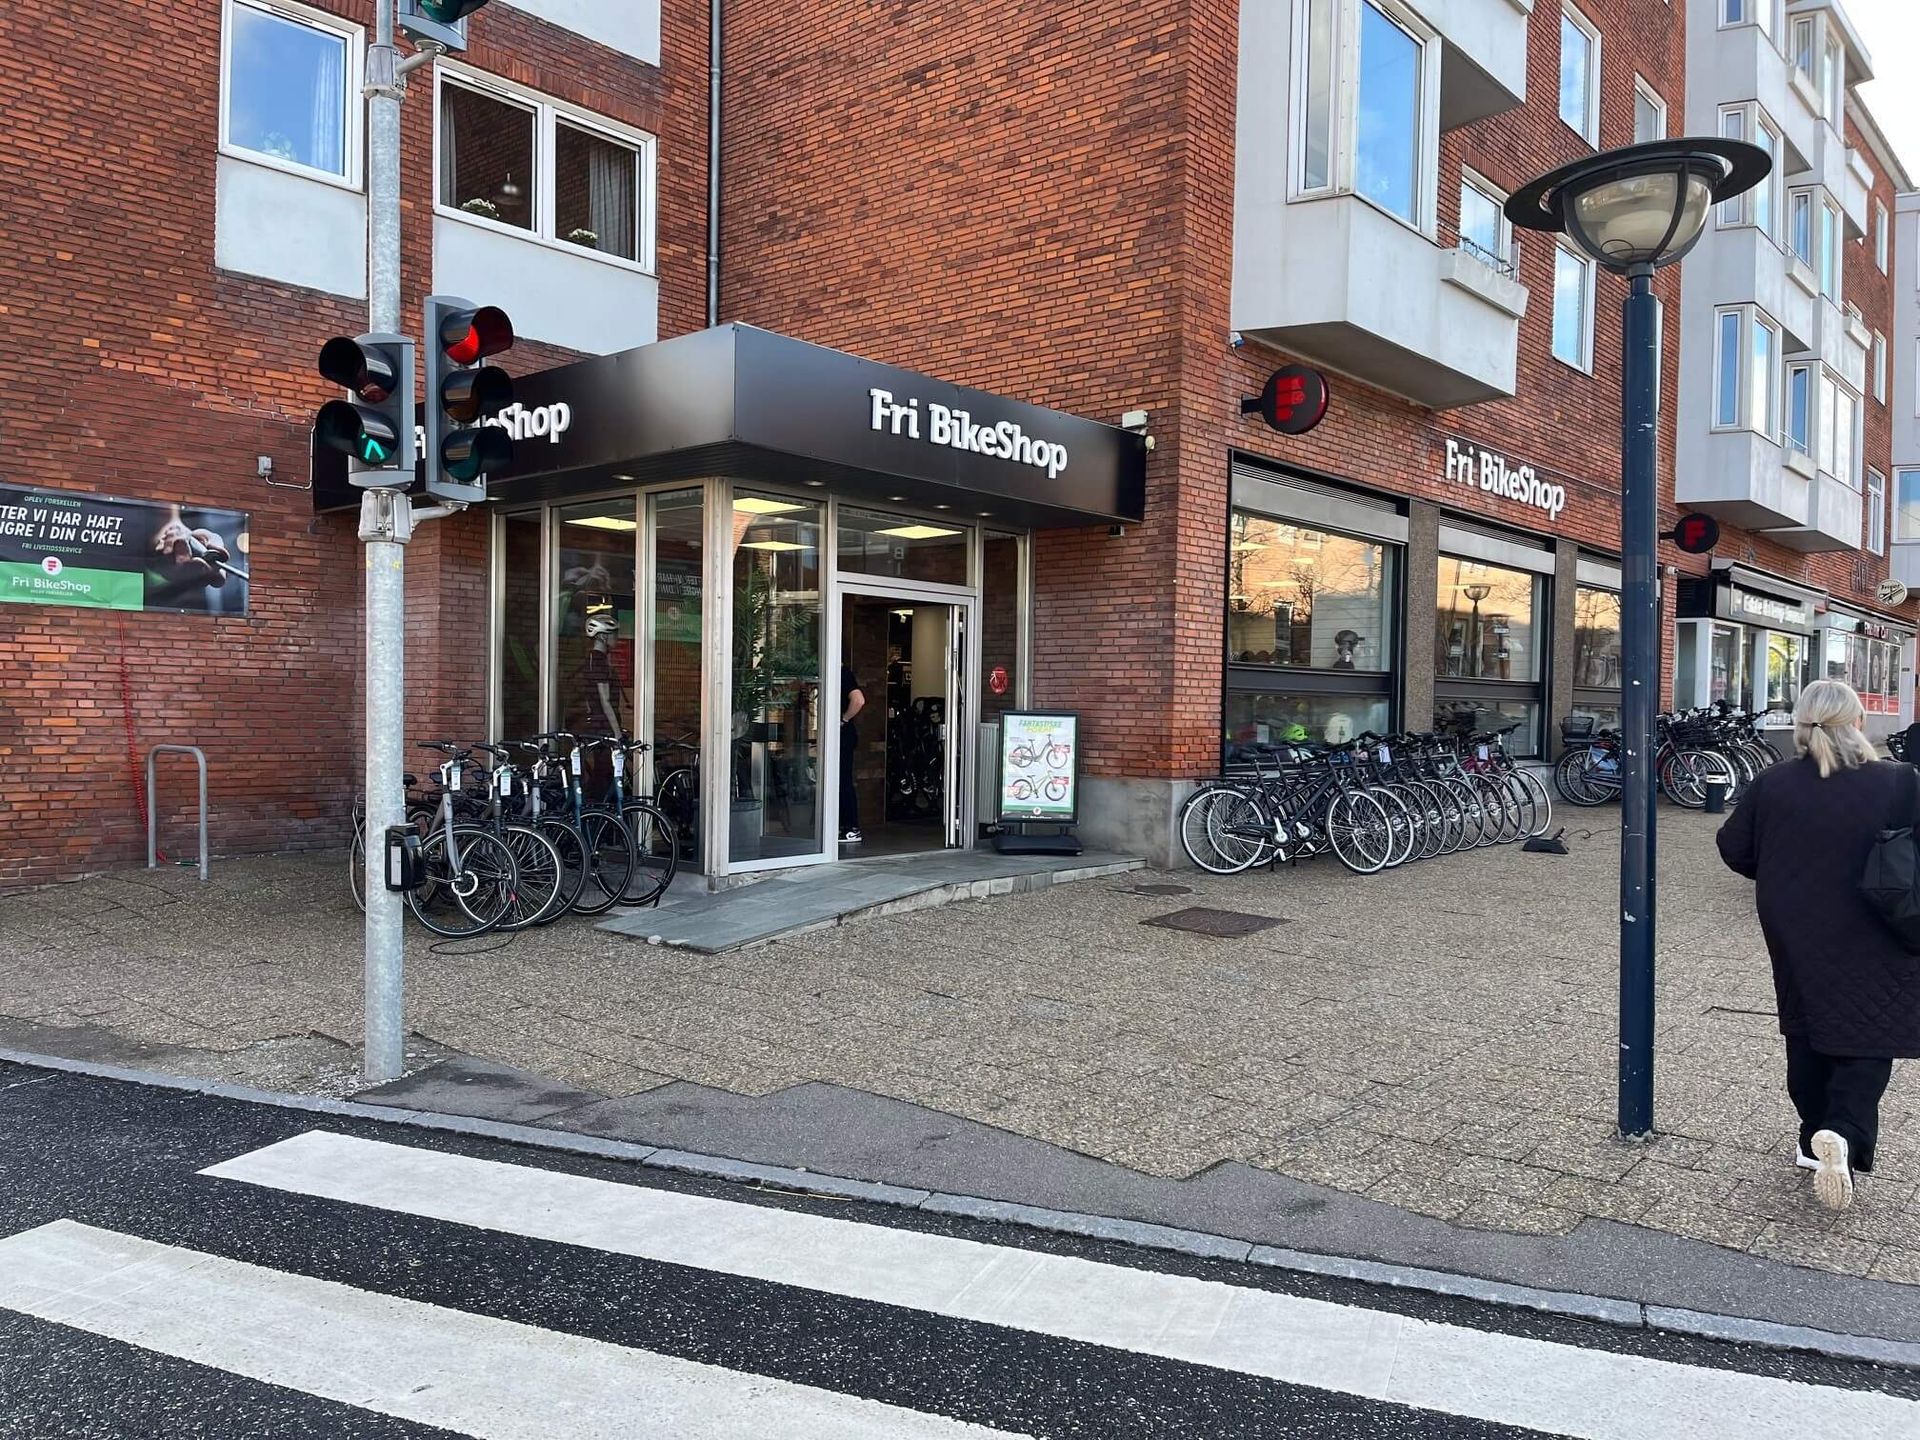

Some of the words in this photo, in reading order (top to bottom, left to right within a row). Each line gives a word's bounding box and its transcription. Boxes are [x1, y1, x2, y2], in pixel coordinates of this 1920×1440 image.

[870, 388, 920, 439] Fri
[928, 403, 1068, 479] BikeShop
[1445, 438, 1474, 486] Fri
[1479, 451, 1565, 520] BikeShop
[24, 495, 43, 503] OPLEV
[45, 497, 82, 507] FORSKELLEN
[0, 504, 28, 520] TER
[33, 508, 47, 522] VI
[51, 510, 81, 526] HAR
[86, 514, 123, 530] HAFT
[39, 525, 45, 538] I
[49, 526, 76, 541] DIN
[80, 529, 124, 546] CYKEL
[12, 576, 30, 587] Fri
[34, 578, 92, 593] BikeShop
